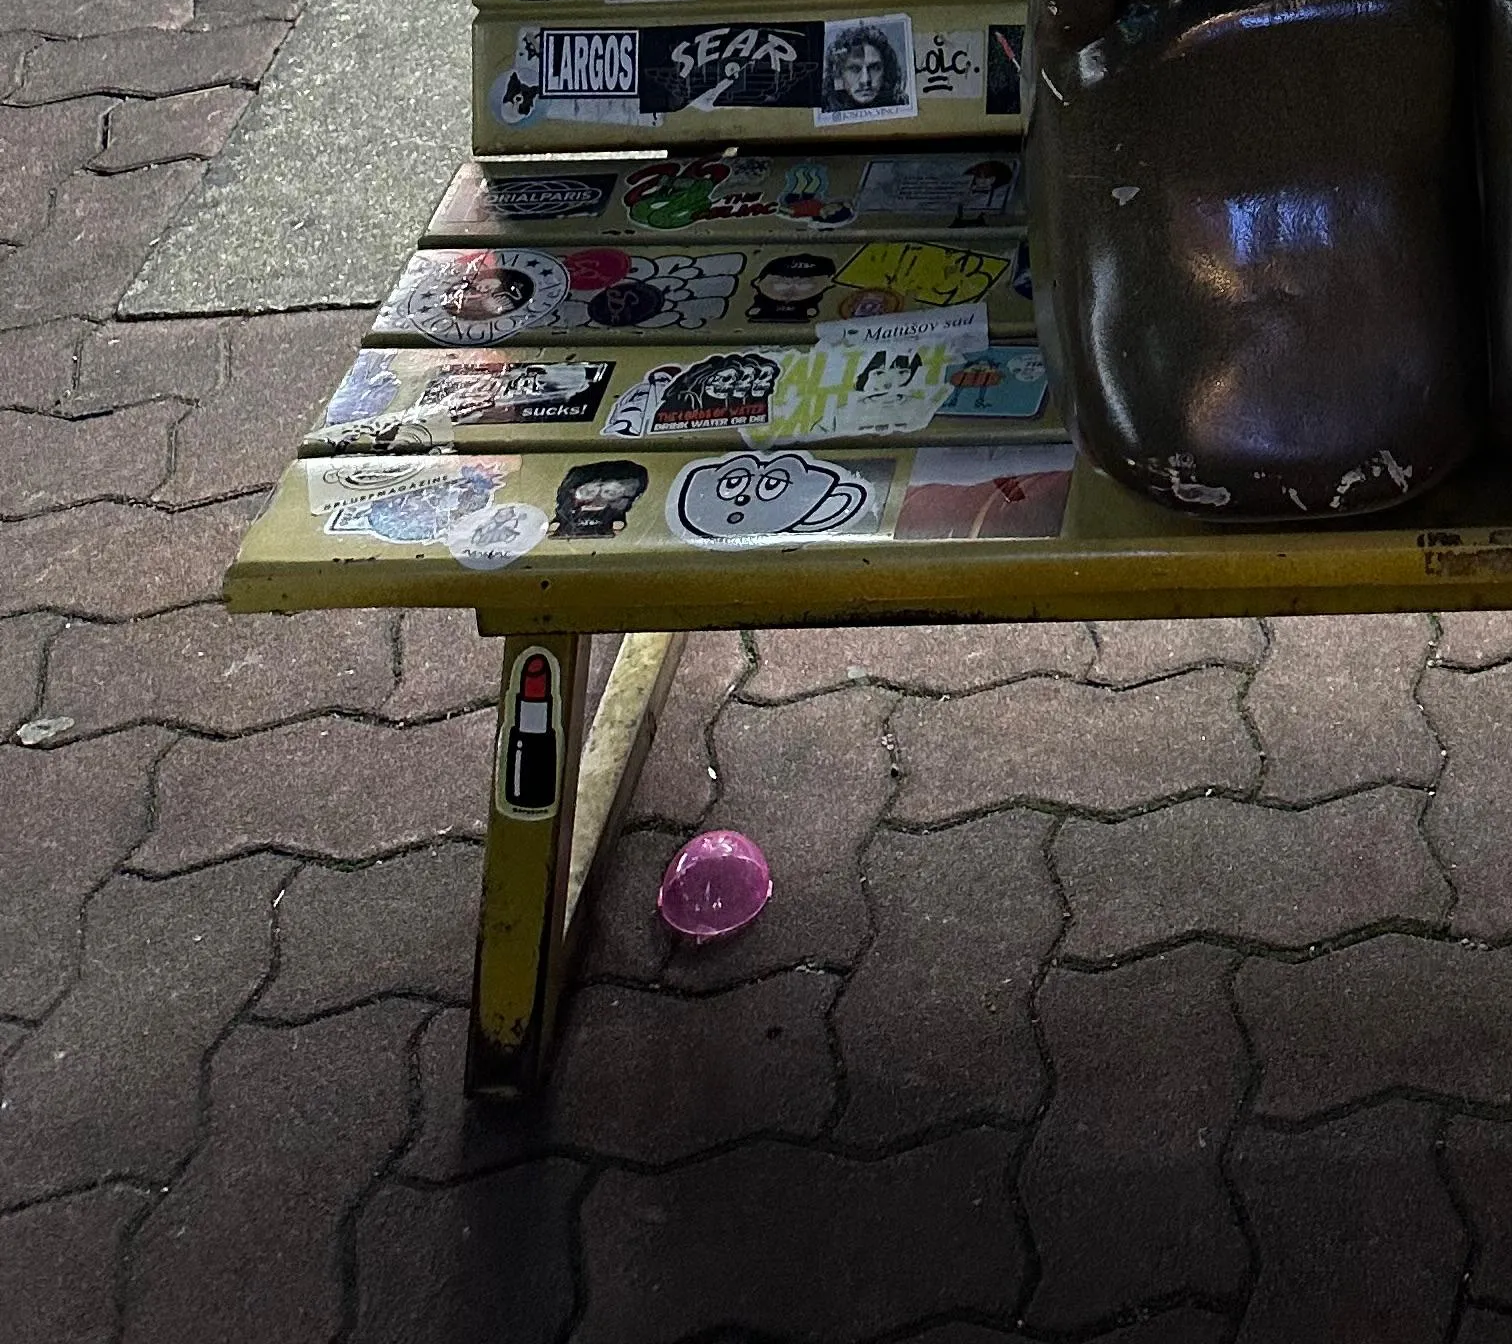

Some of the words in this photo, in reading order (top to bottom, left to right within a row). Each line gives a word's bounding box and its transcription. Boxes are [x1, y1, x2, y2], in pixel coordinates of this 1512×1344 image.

[547, 34, 633, 90] LARGOS
[672, 28, 798, 78] SEAR
[522, 405, 588, 418] sucks!
[654, 421, 688, 431] DRINK
[691, 418, 728, 429] WATER
[731, 416, 748, 425] OR
[749, 414, 767, 424] DIE
